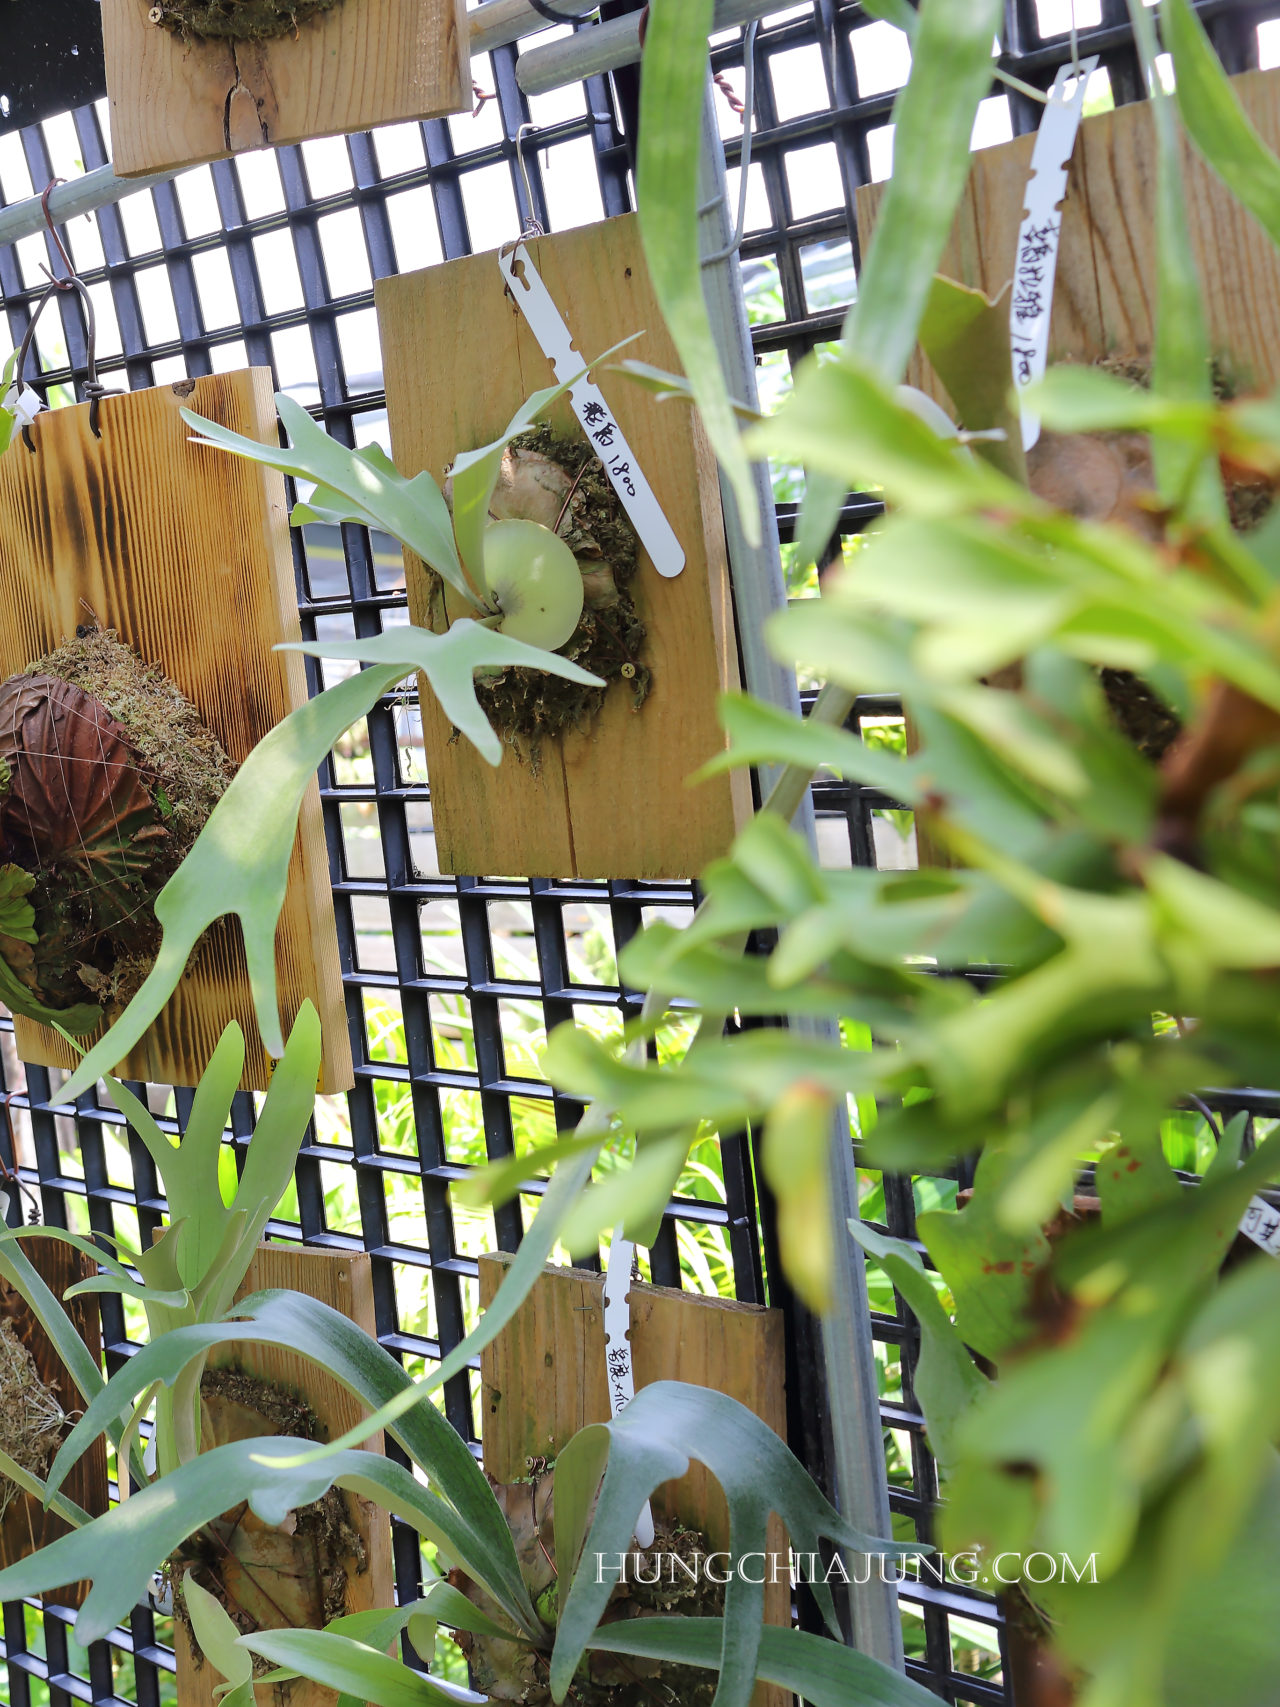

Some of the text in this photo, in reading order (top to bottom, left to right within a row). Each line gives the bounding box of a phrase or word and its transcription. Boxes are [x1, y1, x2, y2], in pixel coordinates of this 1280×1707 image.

[1010, 333, 1037, 386] 1800
[583, 401, 636, 497] 飛馬 1800
